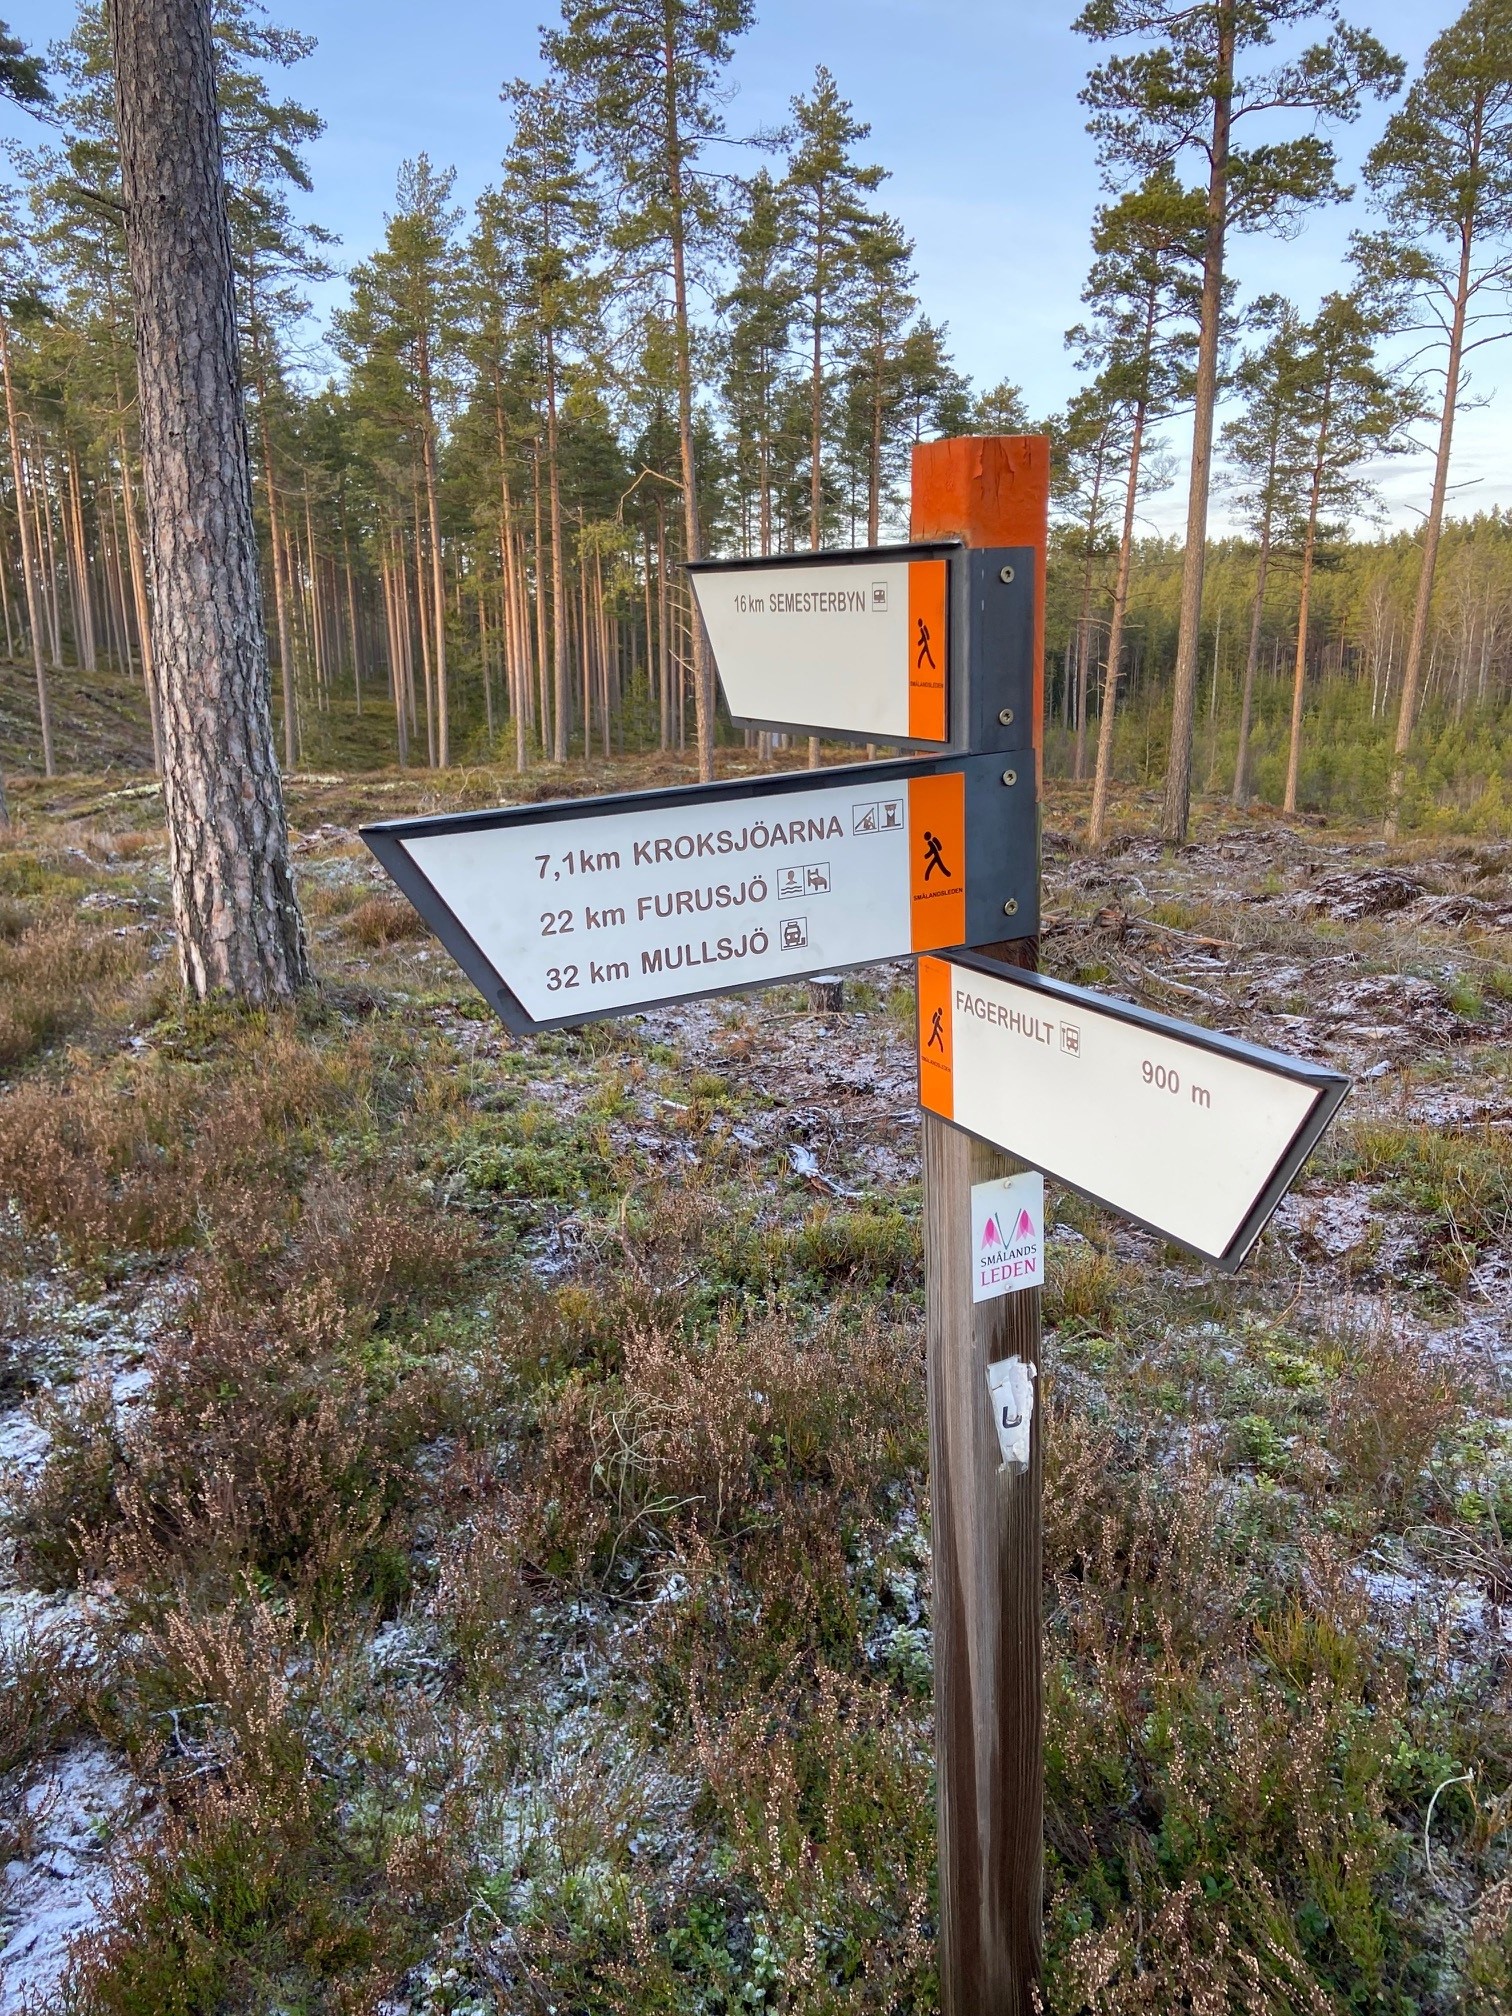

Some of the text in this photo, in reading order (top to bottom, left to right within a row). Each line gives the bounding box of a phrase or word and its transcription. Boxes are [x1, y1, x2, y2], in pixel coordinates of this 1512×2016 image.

[769, 591, 866, 613] SEMESTERBYN
[633, 815, 844, 867] KROKSJÖARNA
[539, 875, 768, 937] 22 km FURUSJÖ
[913, 887, 963, 901] SMÅLANDSLEDEN
[546, 928, 769, 992] 32 km MULLSJÖ
[956, 990, 1211, 1109] FAGERHULT 900 m
[980, 1244, 1037, 1267] SMÅLANDS
[981, 1257, 1037, 1287] LEDEN
